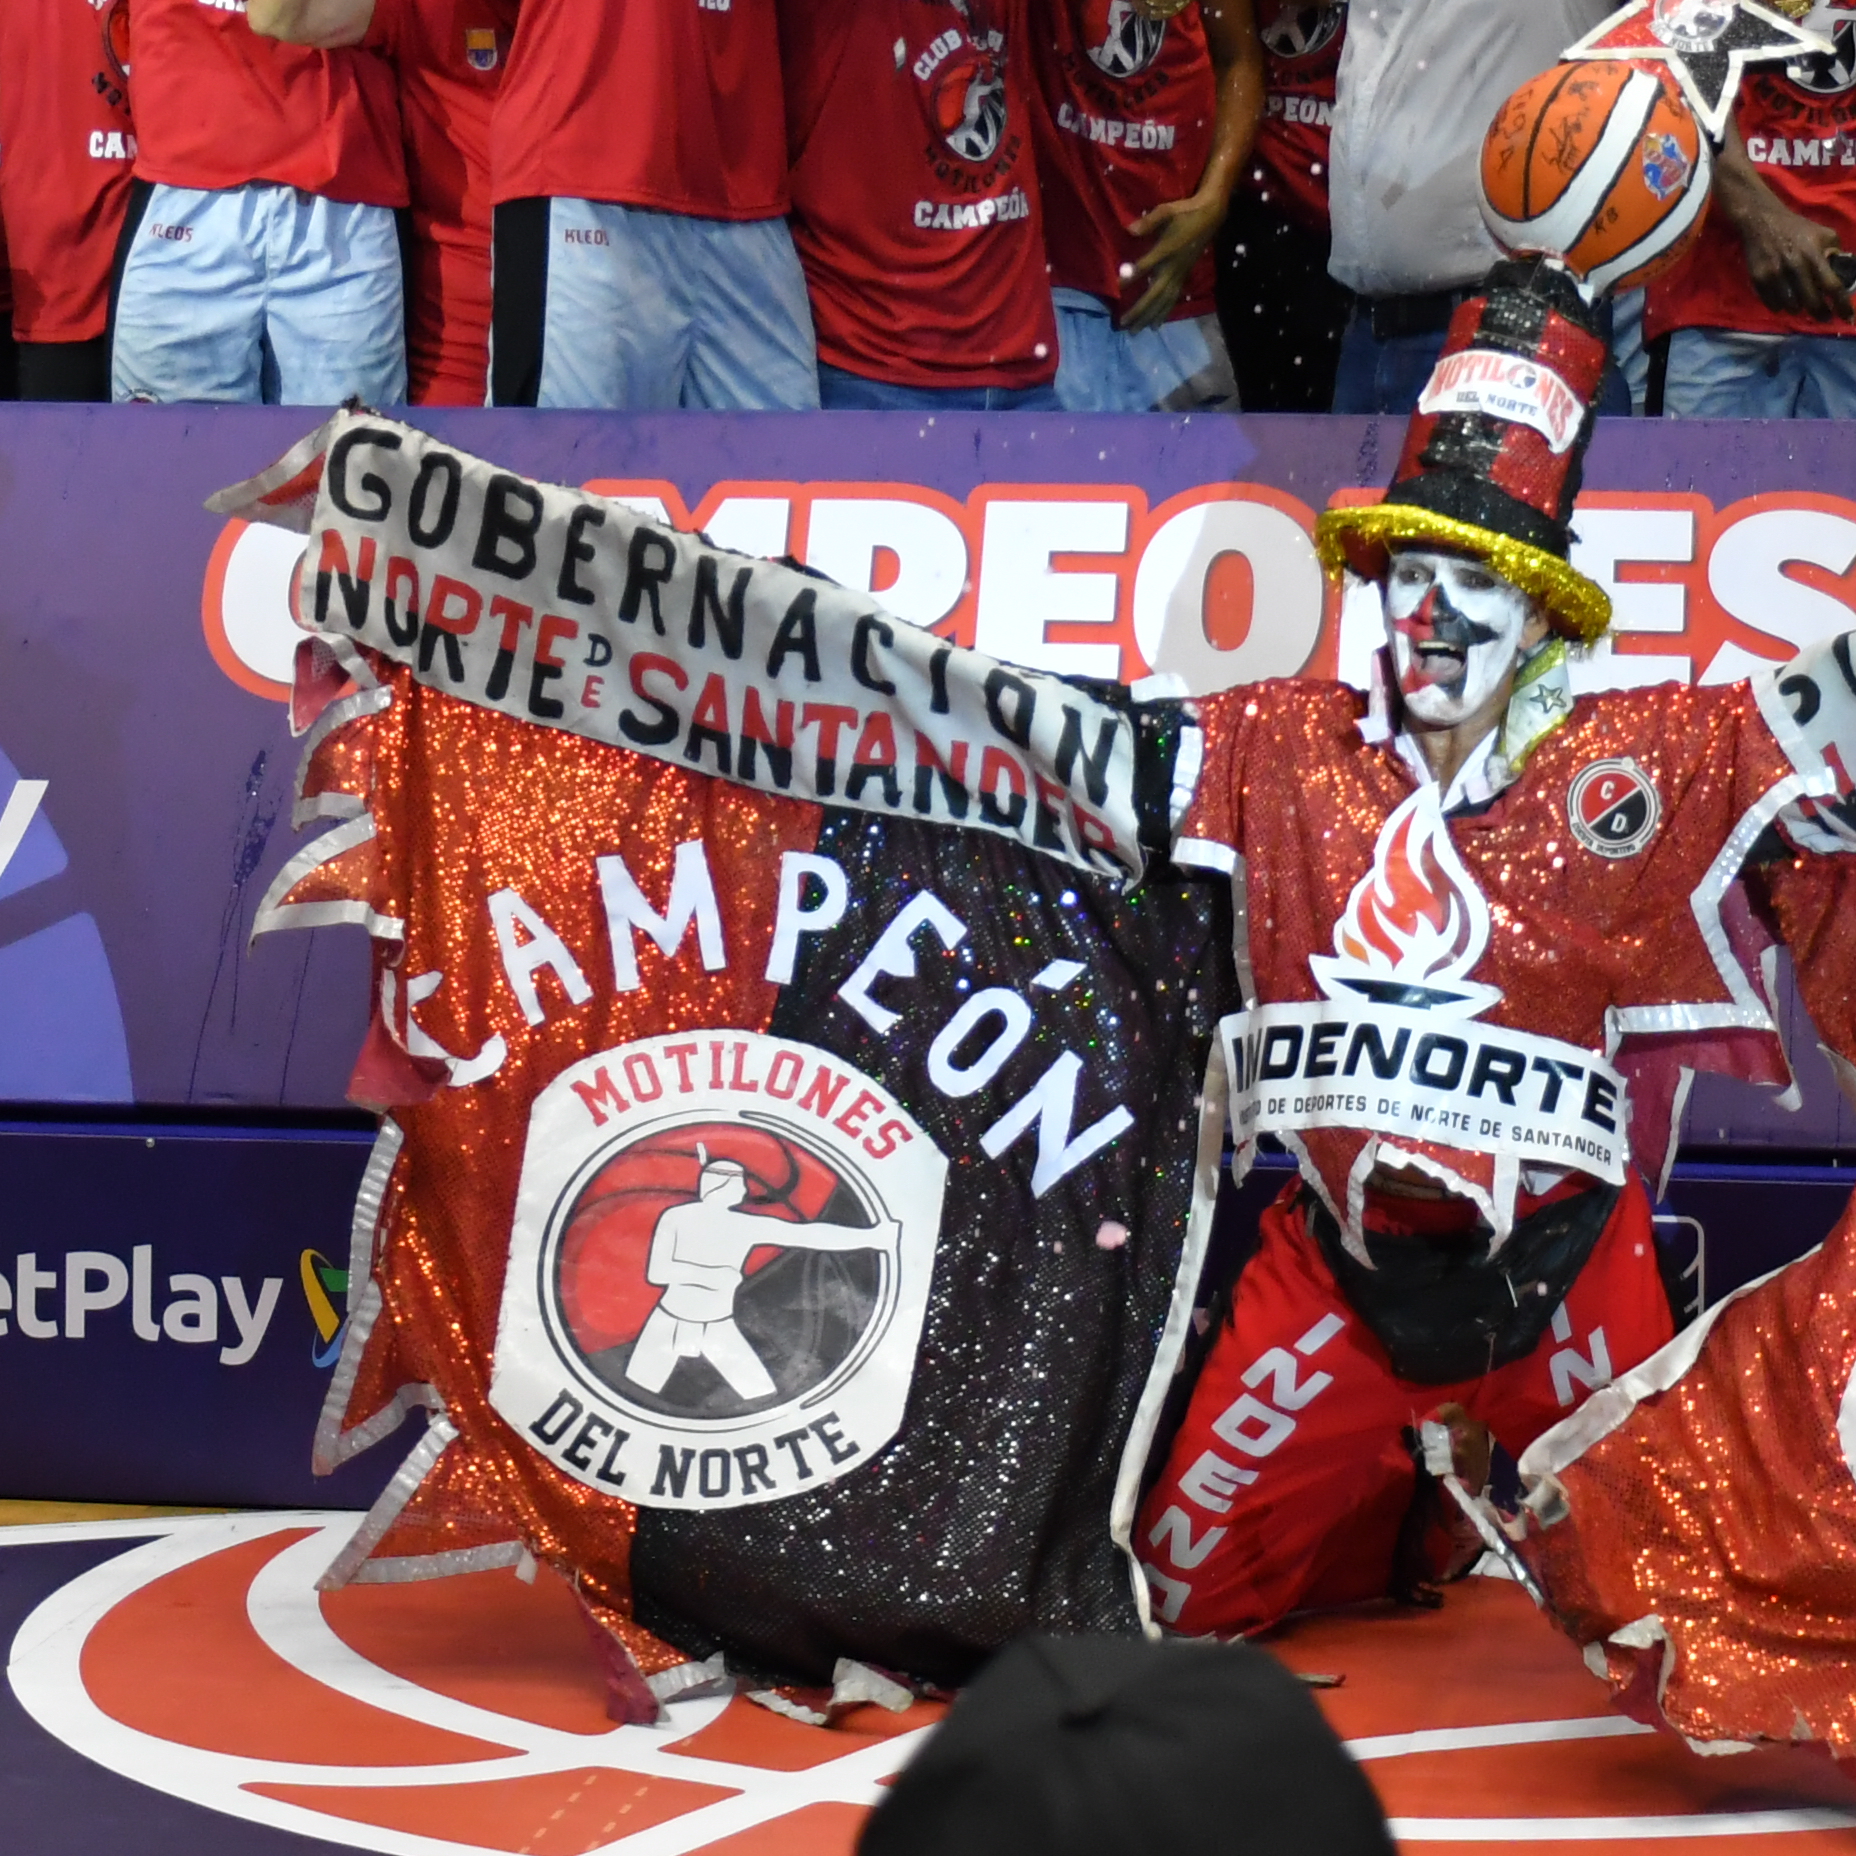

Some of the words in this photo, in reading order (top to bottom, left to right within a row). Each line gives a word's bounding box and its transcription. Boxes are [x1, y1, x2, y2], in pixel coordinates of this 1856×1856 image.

[914, 27, 962, 83] CLUB
[914, 186, 1029, 232] CAMPEÓN
[1485, 392, 1539, 418] NORTE
[326, 424, 1120, 808] GOBERNACION
[312, 529, 581, 721] NORTE
[618, 649, 1122, 868] SANTANDER
[379, 840, 1137, 1200] CAMPEÓN
[571, 1040, 913, 1160] MOTILONES
[1267, 1097, 1286, 1115] DE
[1377, 1097, 1402, 1118] DE
[1479, 1118, 1503, 1139] DE
[1510, 1125, 1613, 1167] SANTANDER
[528, 1388, 633, 1487] DEL
[650, 1410, 862, 1500] NORTE
